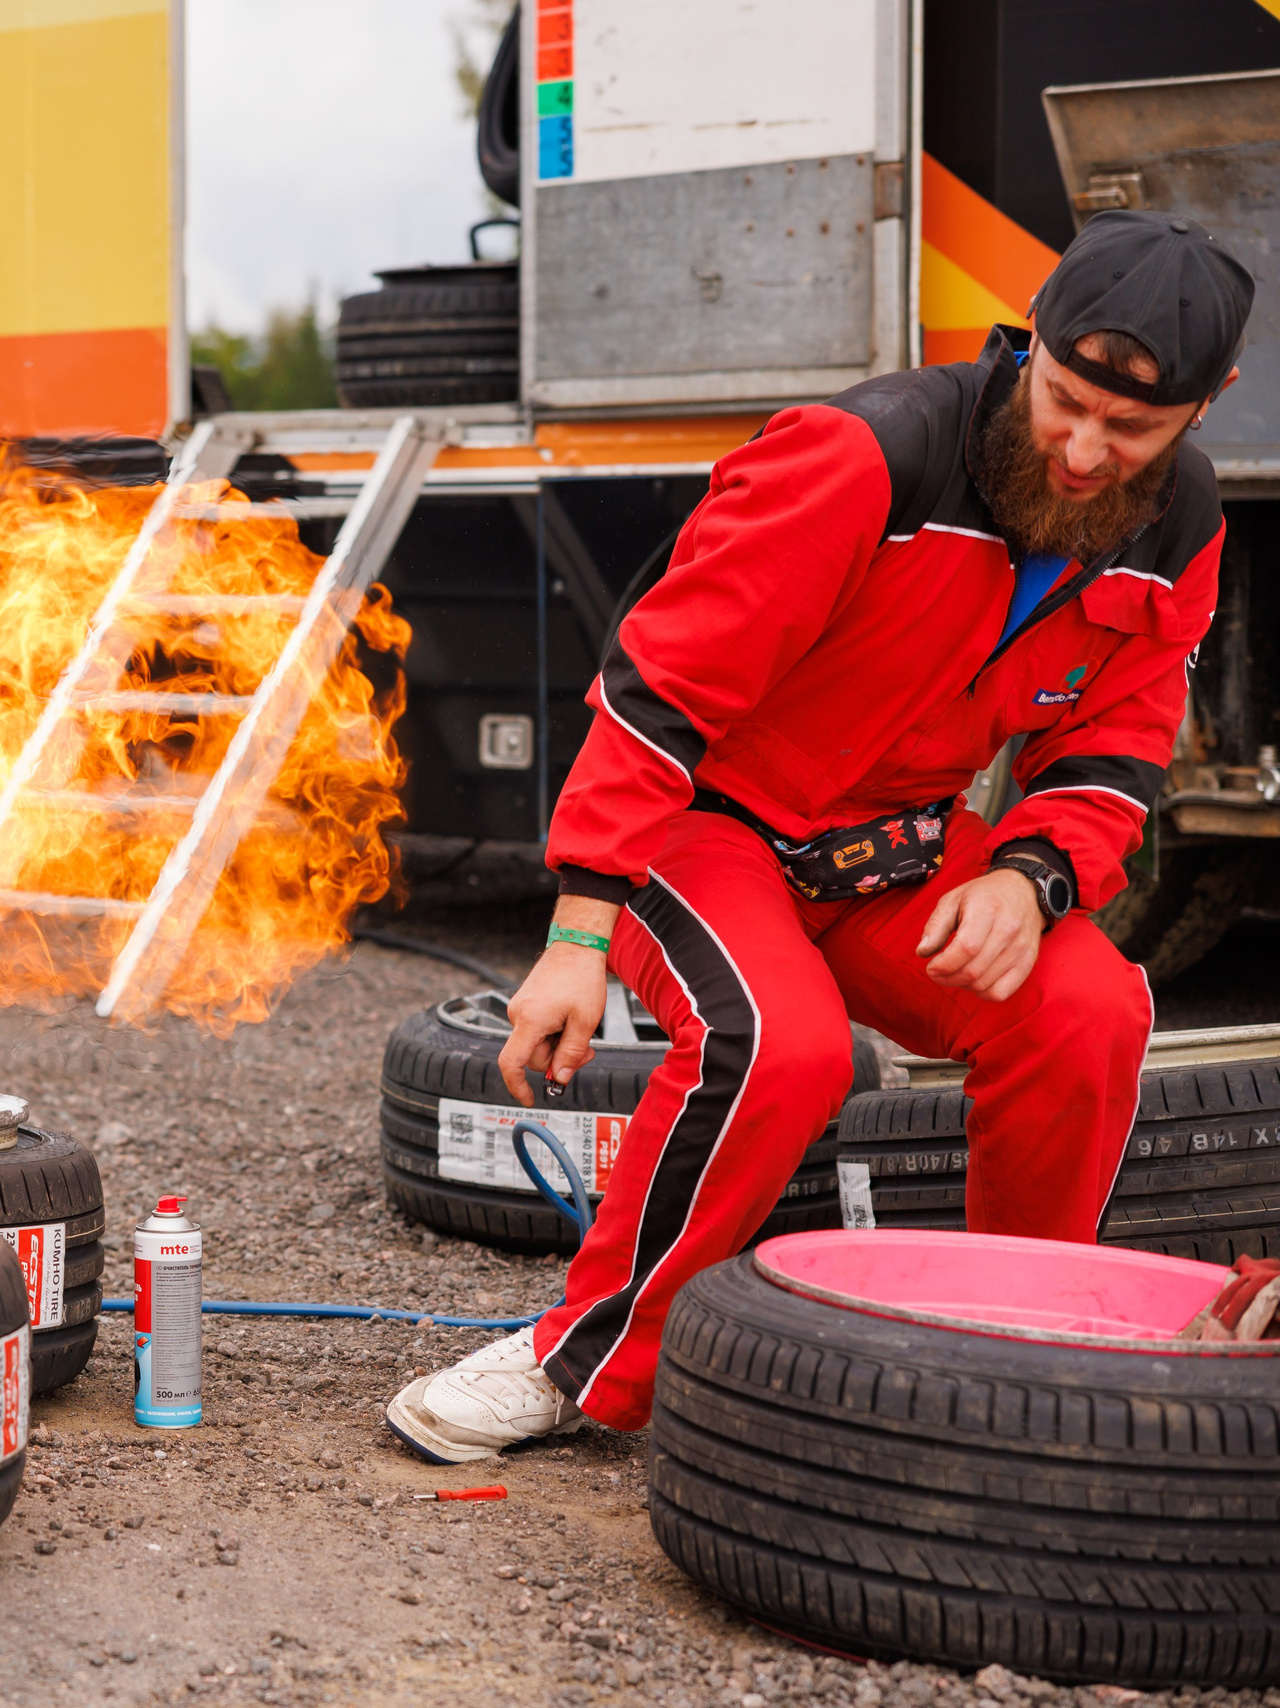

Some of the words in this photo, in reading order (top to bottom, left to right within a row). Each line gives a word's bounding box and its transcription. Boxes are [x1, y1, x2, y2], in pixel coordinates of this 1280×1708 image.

[582, 1117, 593, 1150] 235/40
[1192, 1132, 1238, 1151] 14B
[582, 1152, 592, 1176] ZR18
[599, 1140, 608, 1169] PS91
[52, 1228, 61, 1286] KUMHO
[160, 1244, 189, 1255] mte
[50, 1287, 60, 1321] TIRE
[156, 1391, 173, 1399] 500
